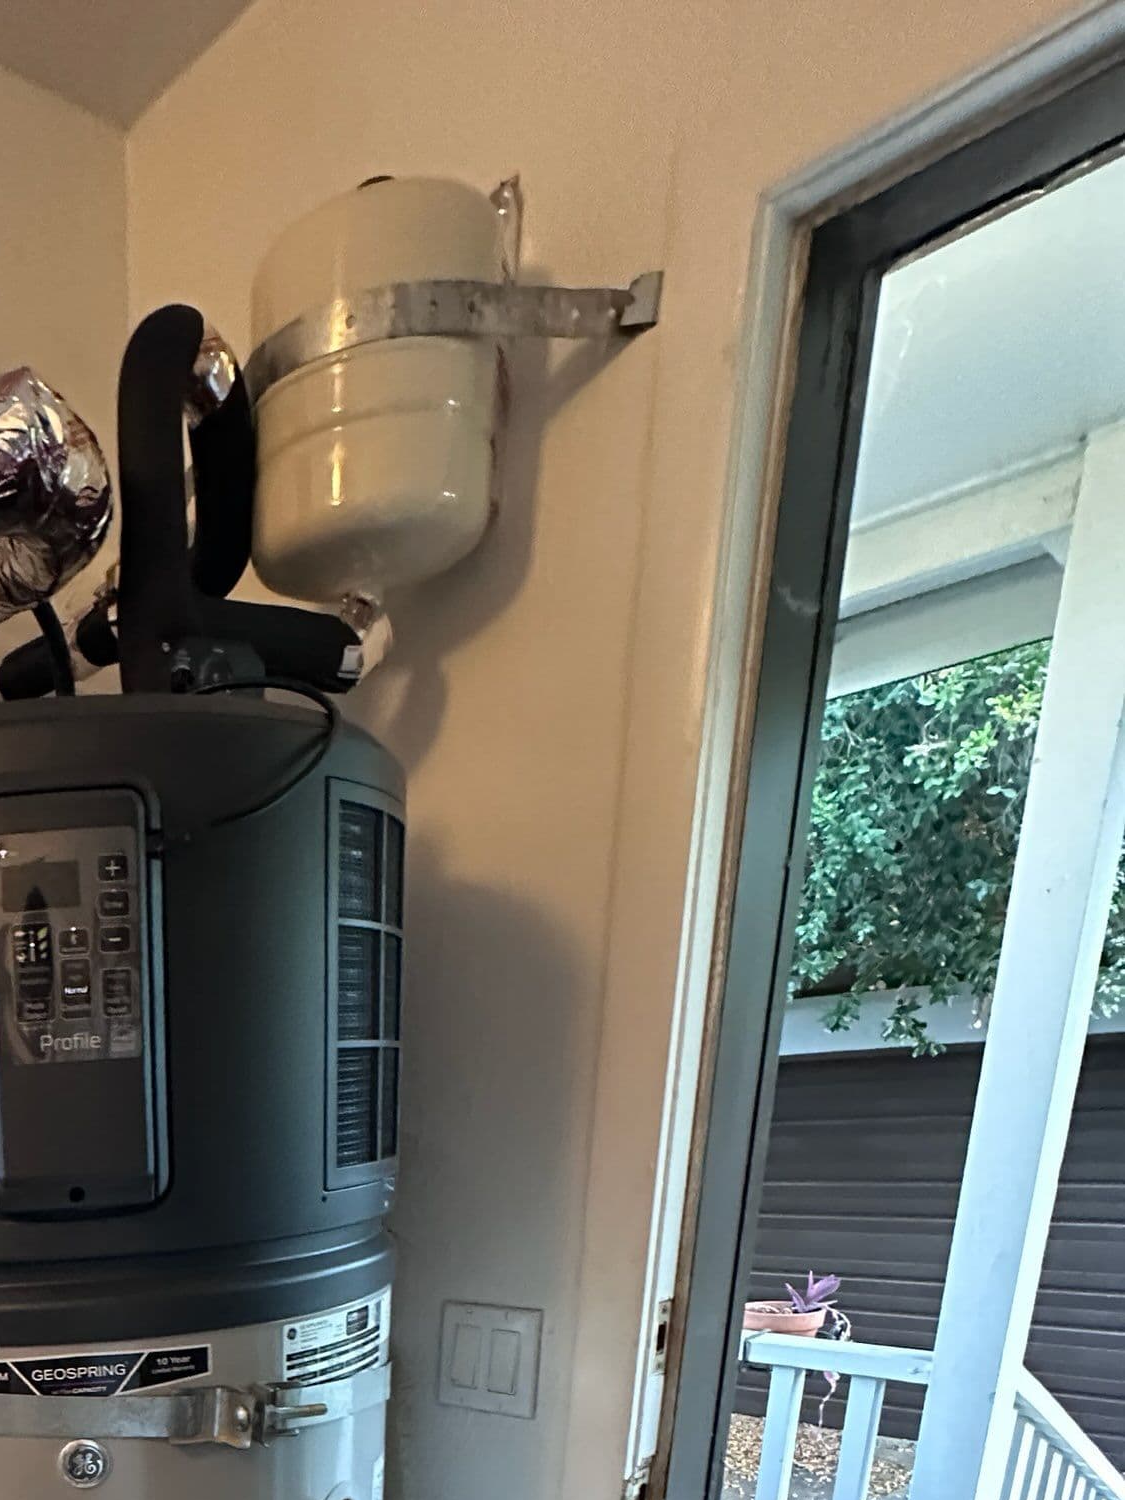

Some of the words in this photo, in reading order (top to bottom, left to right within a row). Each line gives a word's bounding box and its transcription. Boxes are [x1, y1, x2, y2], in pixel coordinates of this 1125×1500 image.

[64, 985, 88, 996] Normal
[40, 1031, 101, 1052] Profile
[31, 1362, 126, 1382] GEOSPRING
